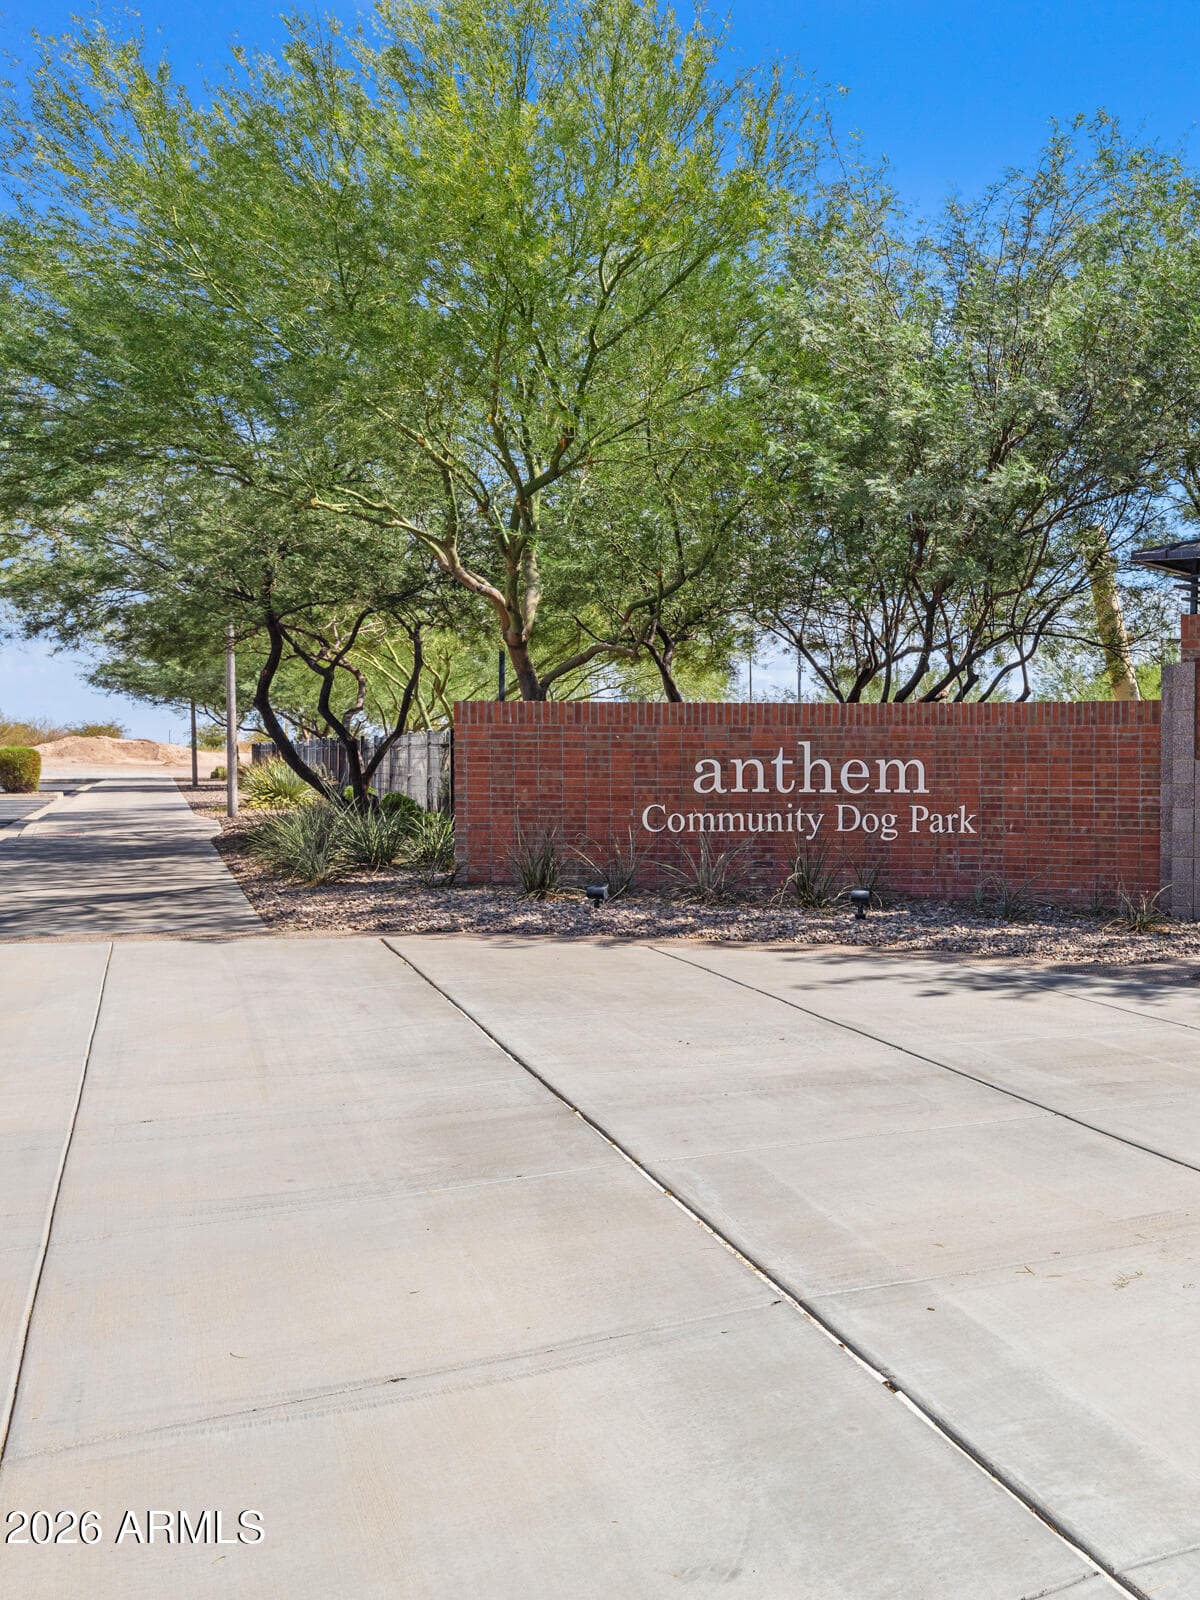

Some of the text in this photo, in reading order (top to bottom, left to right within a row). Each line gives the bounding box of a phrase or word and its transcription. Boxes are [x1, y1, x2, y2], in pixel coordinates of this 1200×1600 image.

[693, 740, 930, 794] anthem
[641, 803, 977, 841] Community Dog Park
